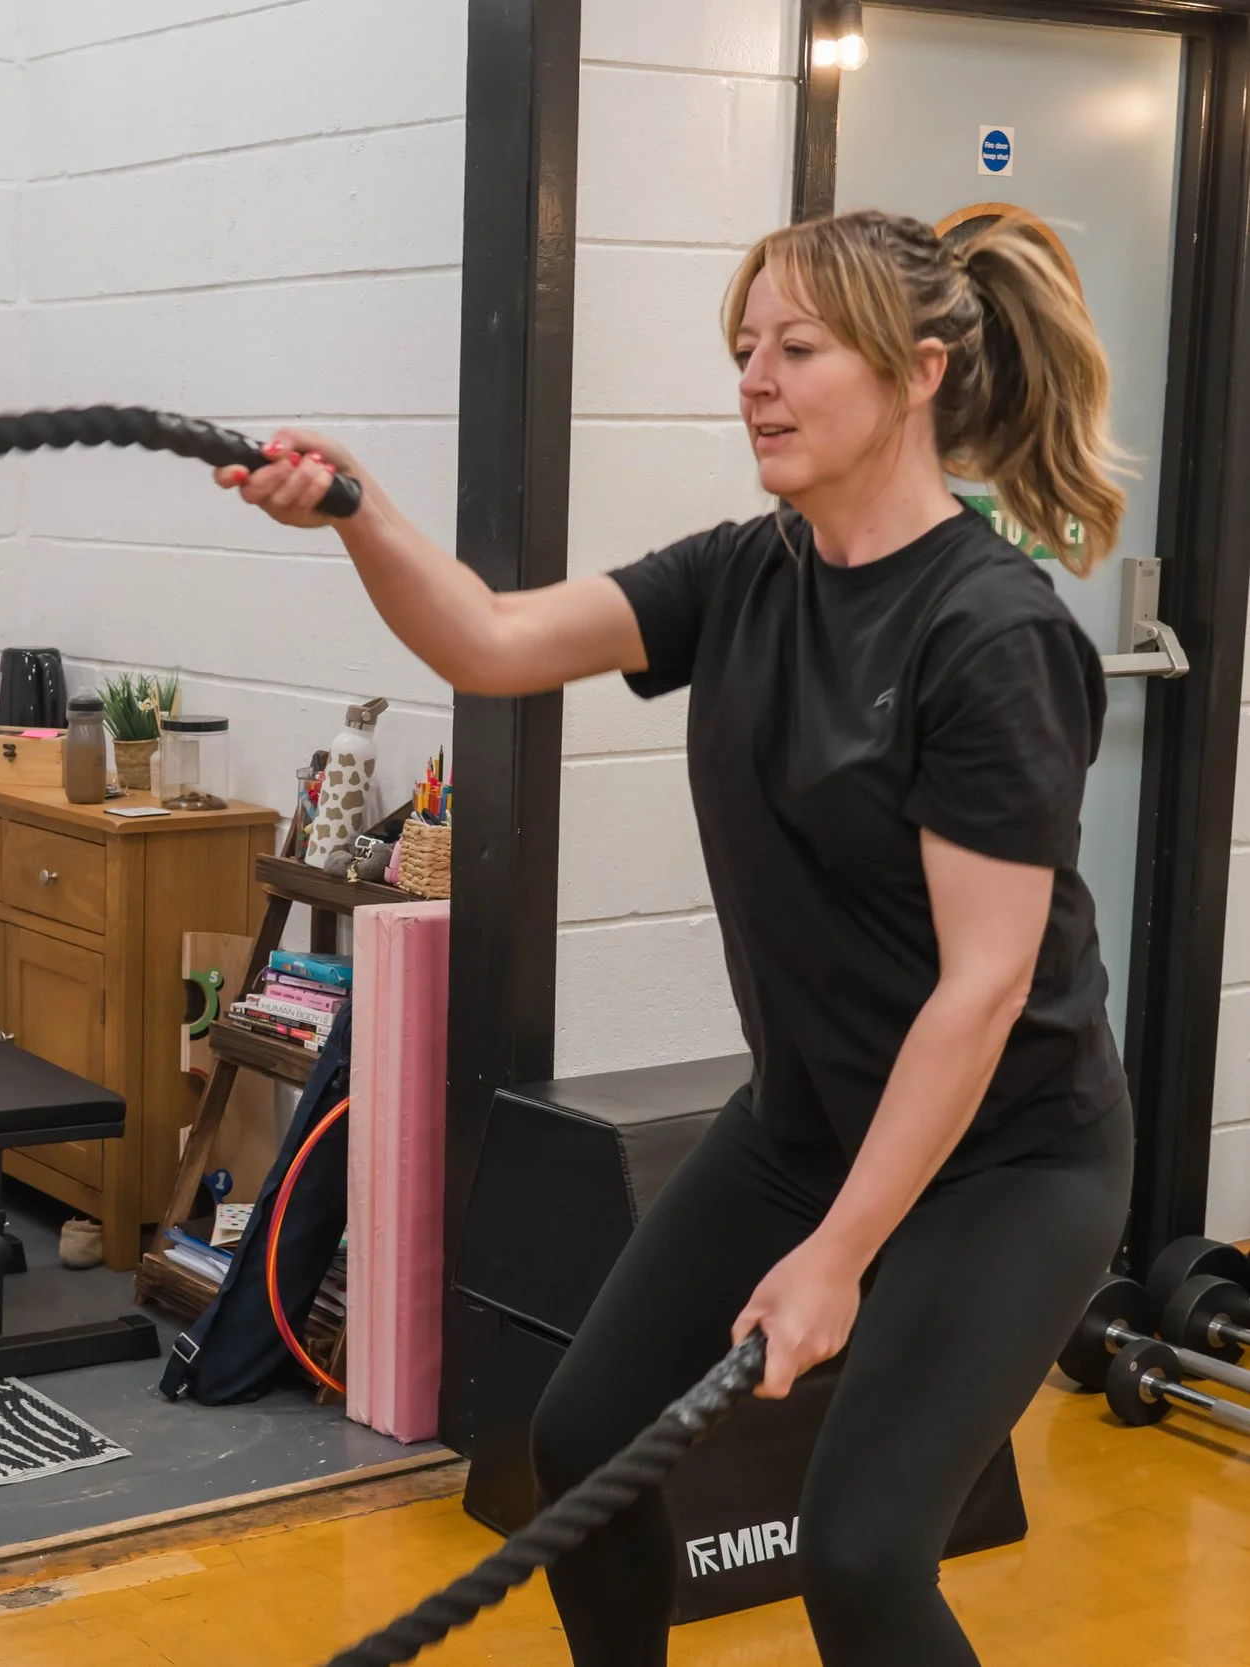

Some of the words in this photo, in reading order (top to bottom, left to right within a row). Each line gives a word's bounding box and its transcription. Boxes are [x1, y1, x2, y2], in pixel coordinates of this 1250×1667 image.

[209, 970, 219, 983] 5
[261, 1001, 295, 1017] HUMAN
[296, 1010, 322, 1023] BODY
